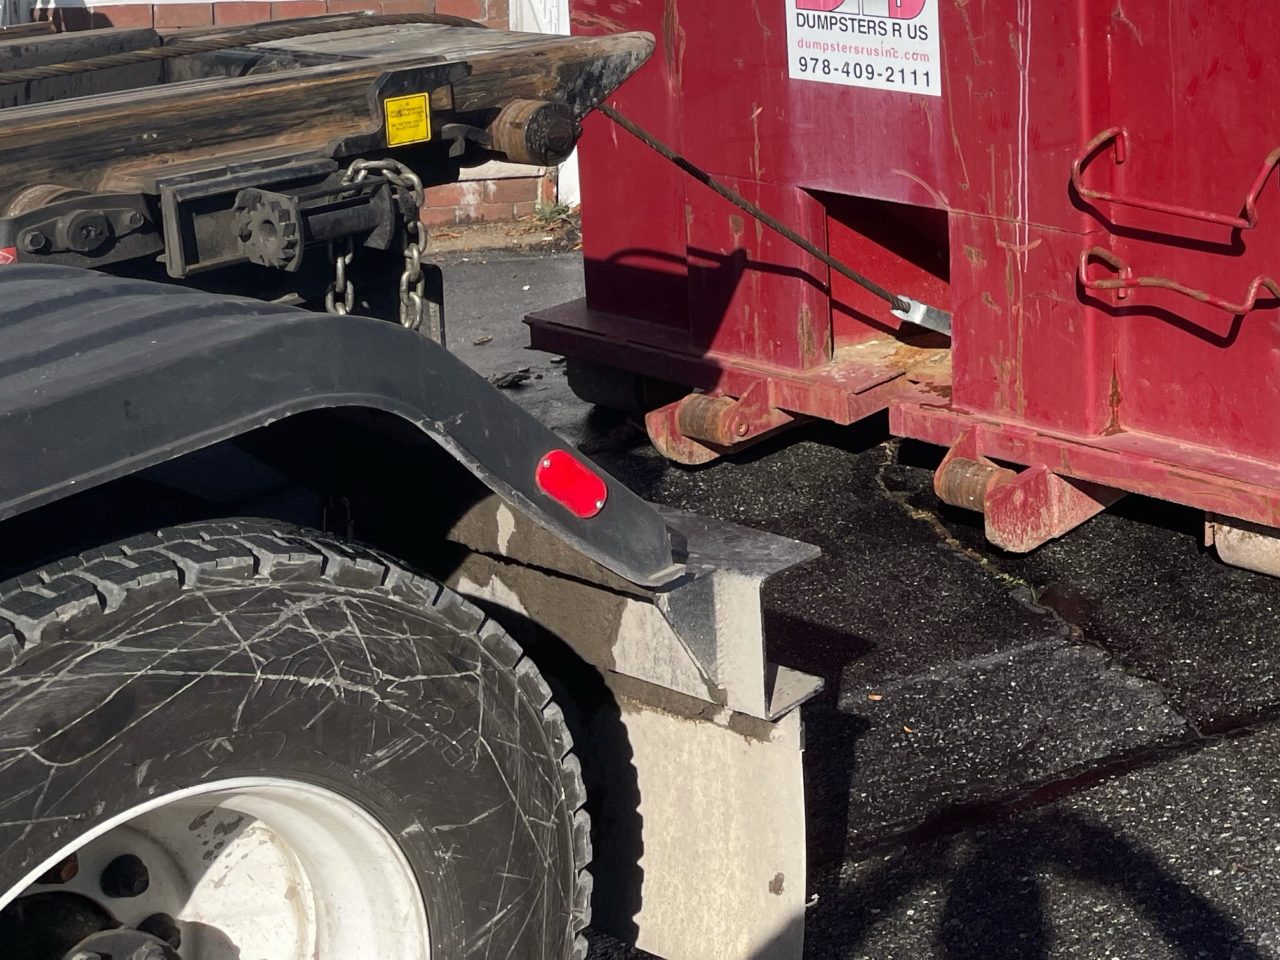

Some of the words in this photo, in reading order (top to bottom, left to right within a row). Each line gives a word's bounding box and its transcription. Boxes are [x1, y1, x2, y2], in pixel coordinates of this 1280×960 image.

[796, 12, 887, 36] DUMPSTERS
[892, 22, 902, 38] R
[907, 23, 929, 40] US
[797, 38, 930, 62] dumpstersrusinc.com
[799, 56, 930, 87] 978-409-2111
